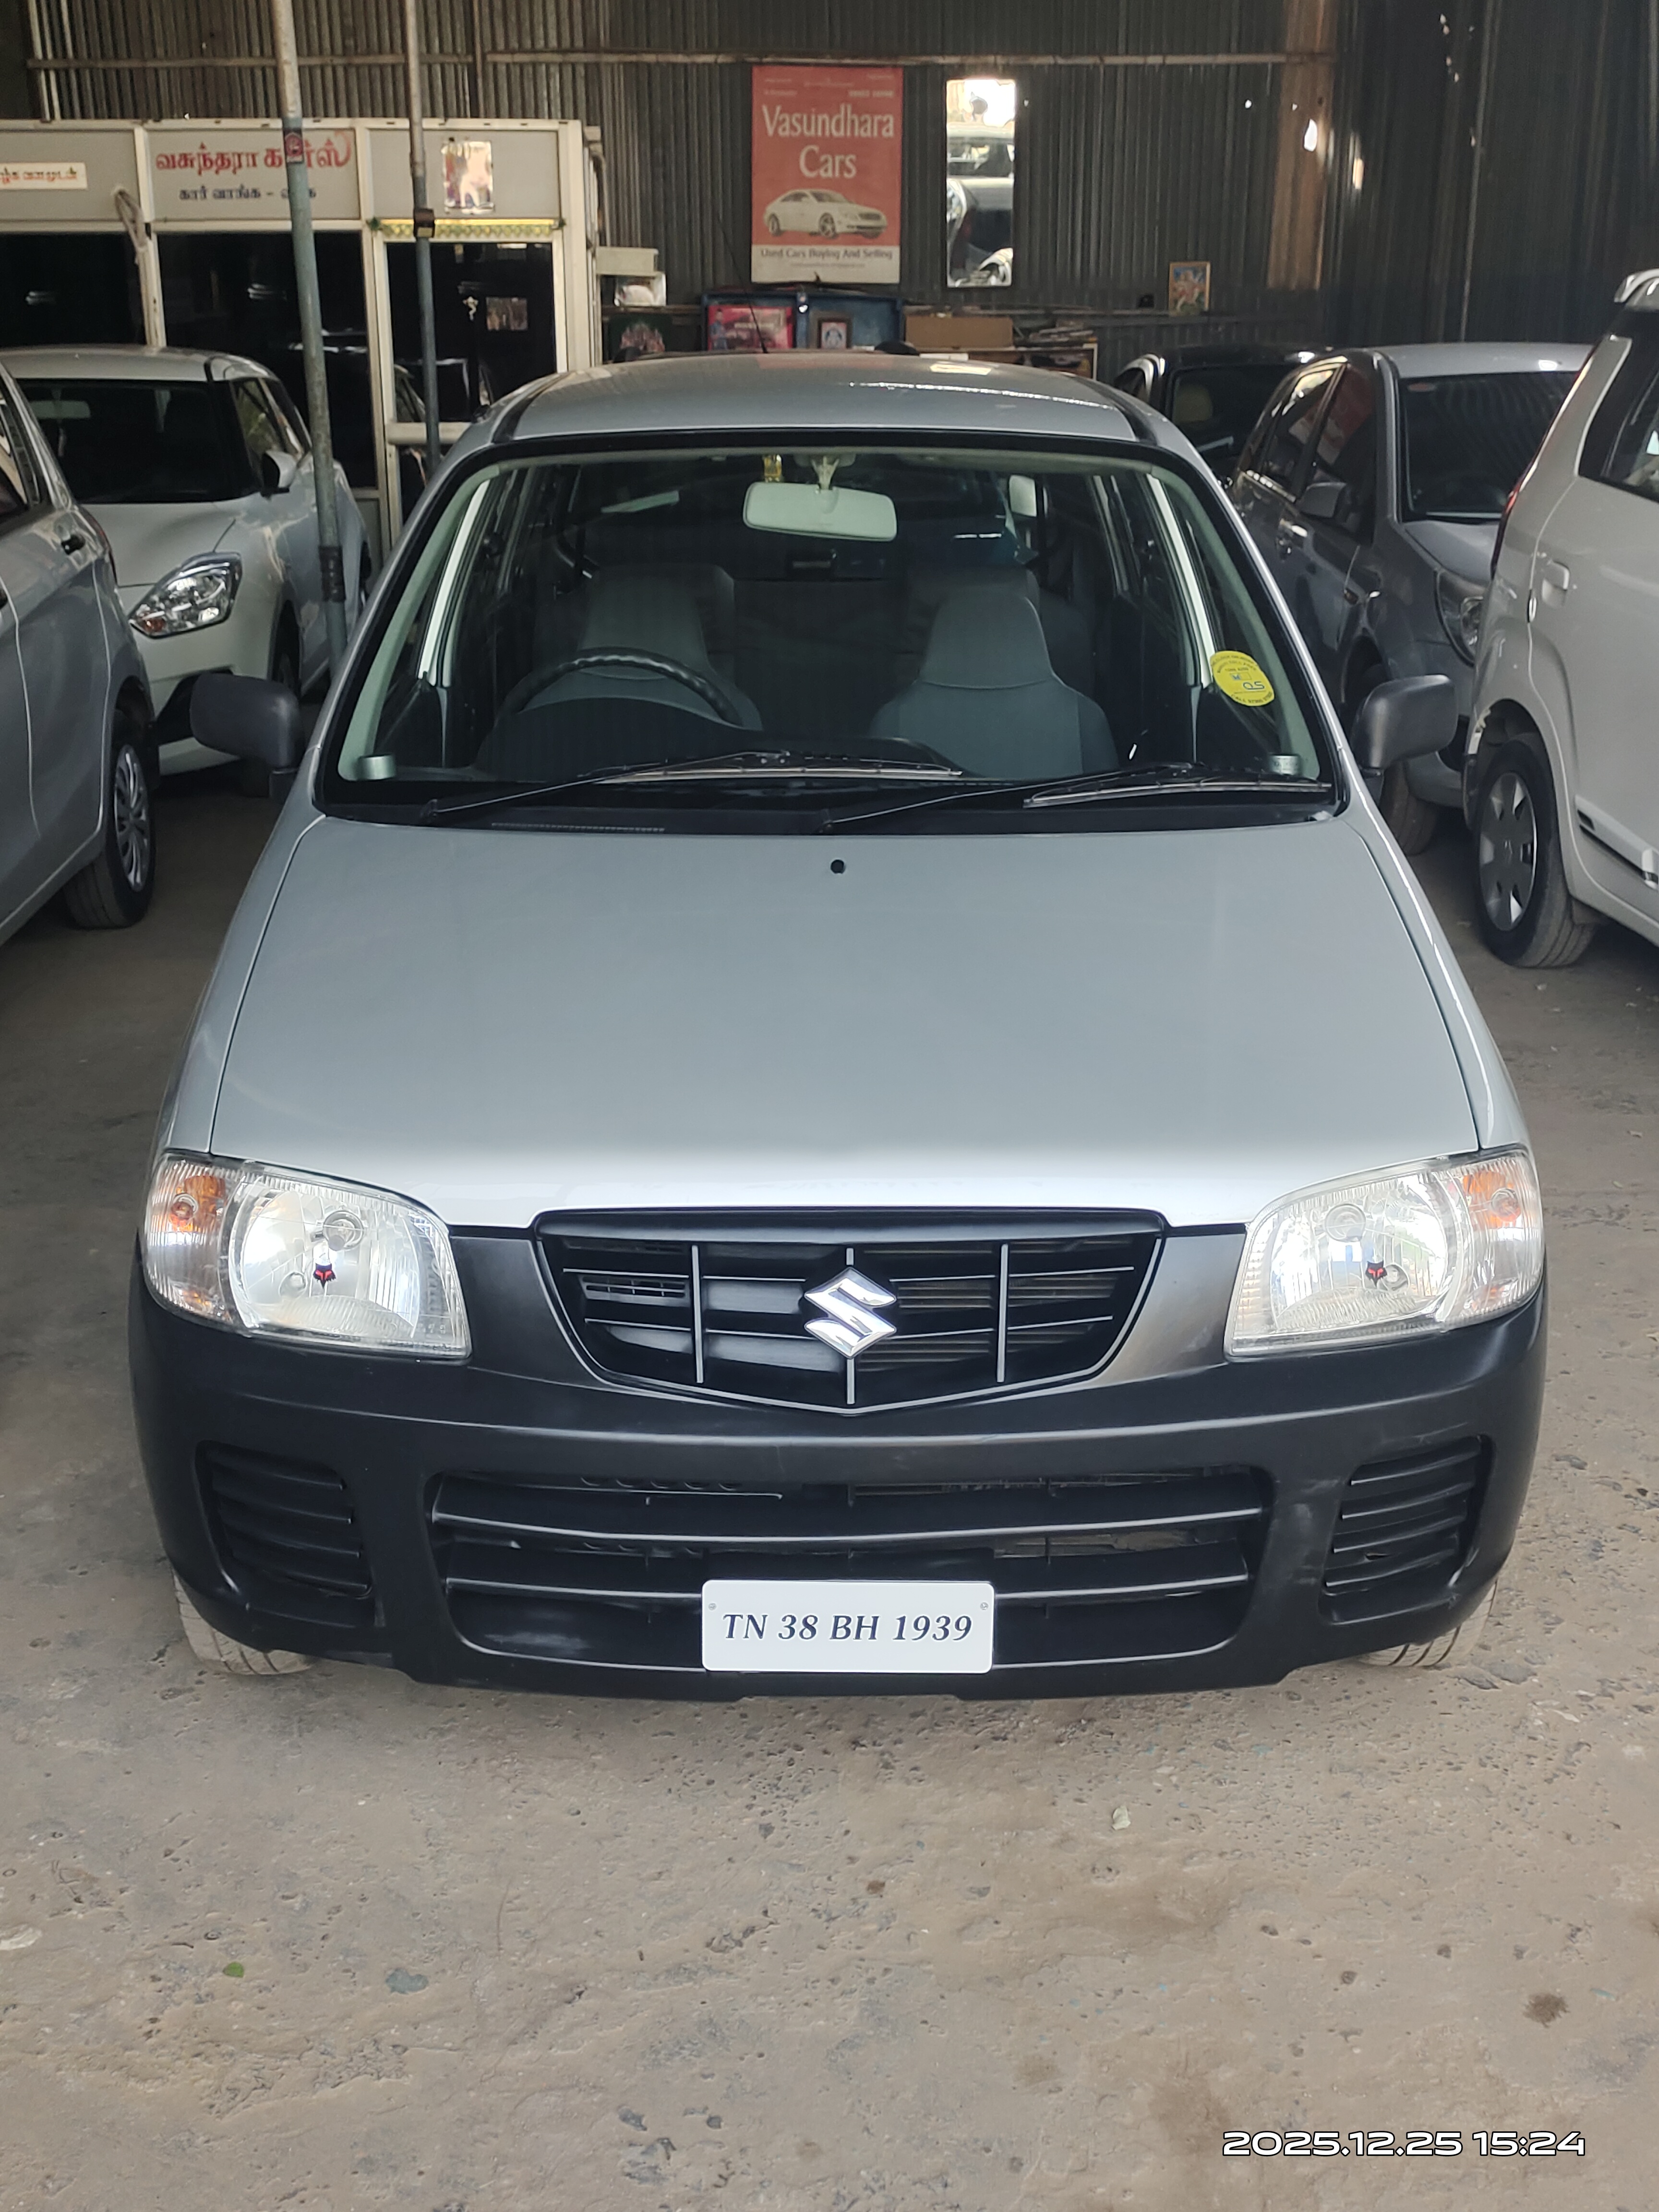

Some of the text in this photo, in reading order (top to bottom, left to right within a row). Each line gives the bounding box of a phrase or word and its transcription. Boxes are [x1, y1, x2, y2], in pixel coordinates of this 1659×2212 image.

[762, 102, 894, 137] Vasundhara
[155, 142, 259, 176] வசுந்தரா
[799, 144, 857, 178] Cars
[179, 185, 207, 201] கார்
[212, 183, 262, 200] வாங்க
[761, 248, 893, 260] Used Cars Buying And Selling
[722, 1614, 973, 1641] TN 38 BH 1939
